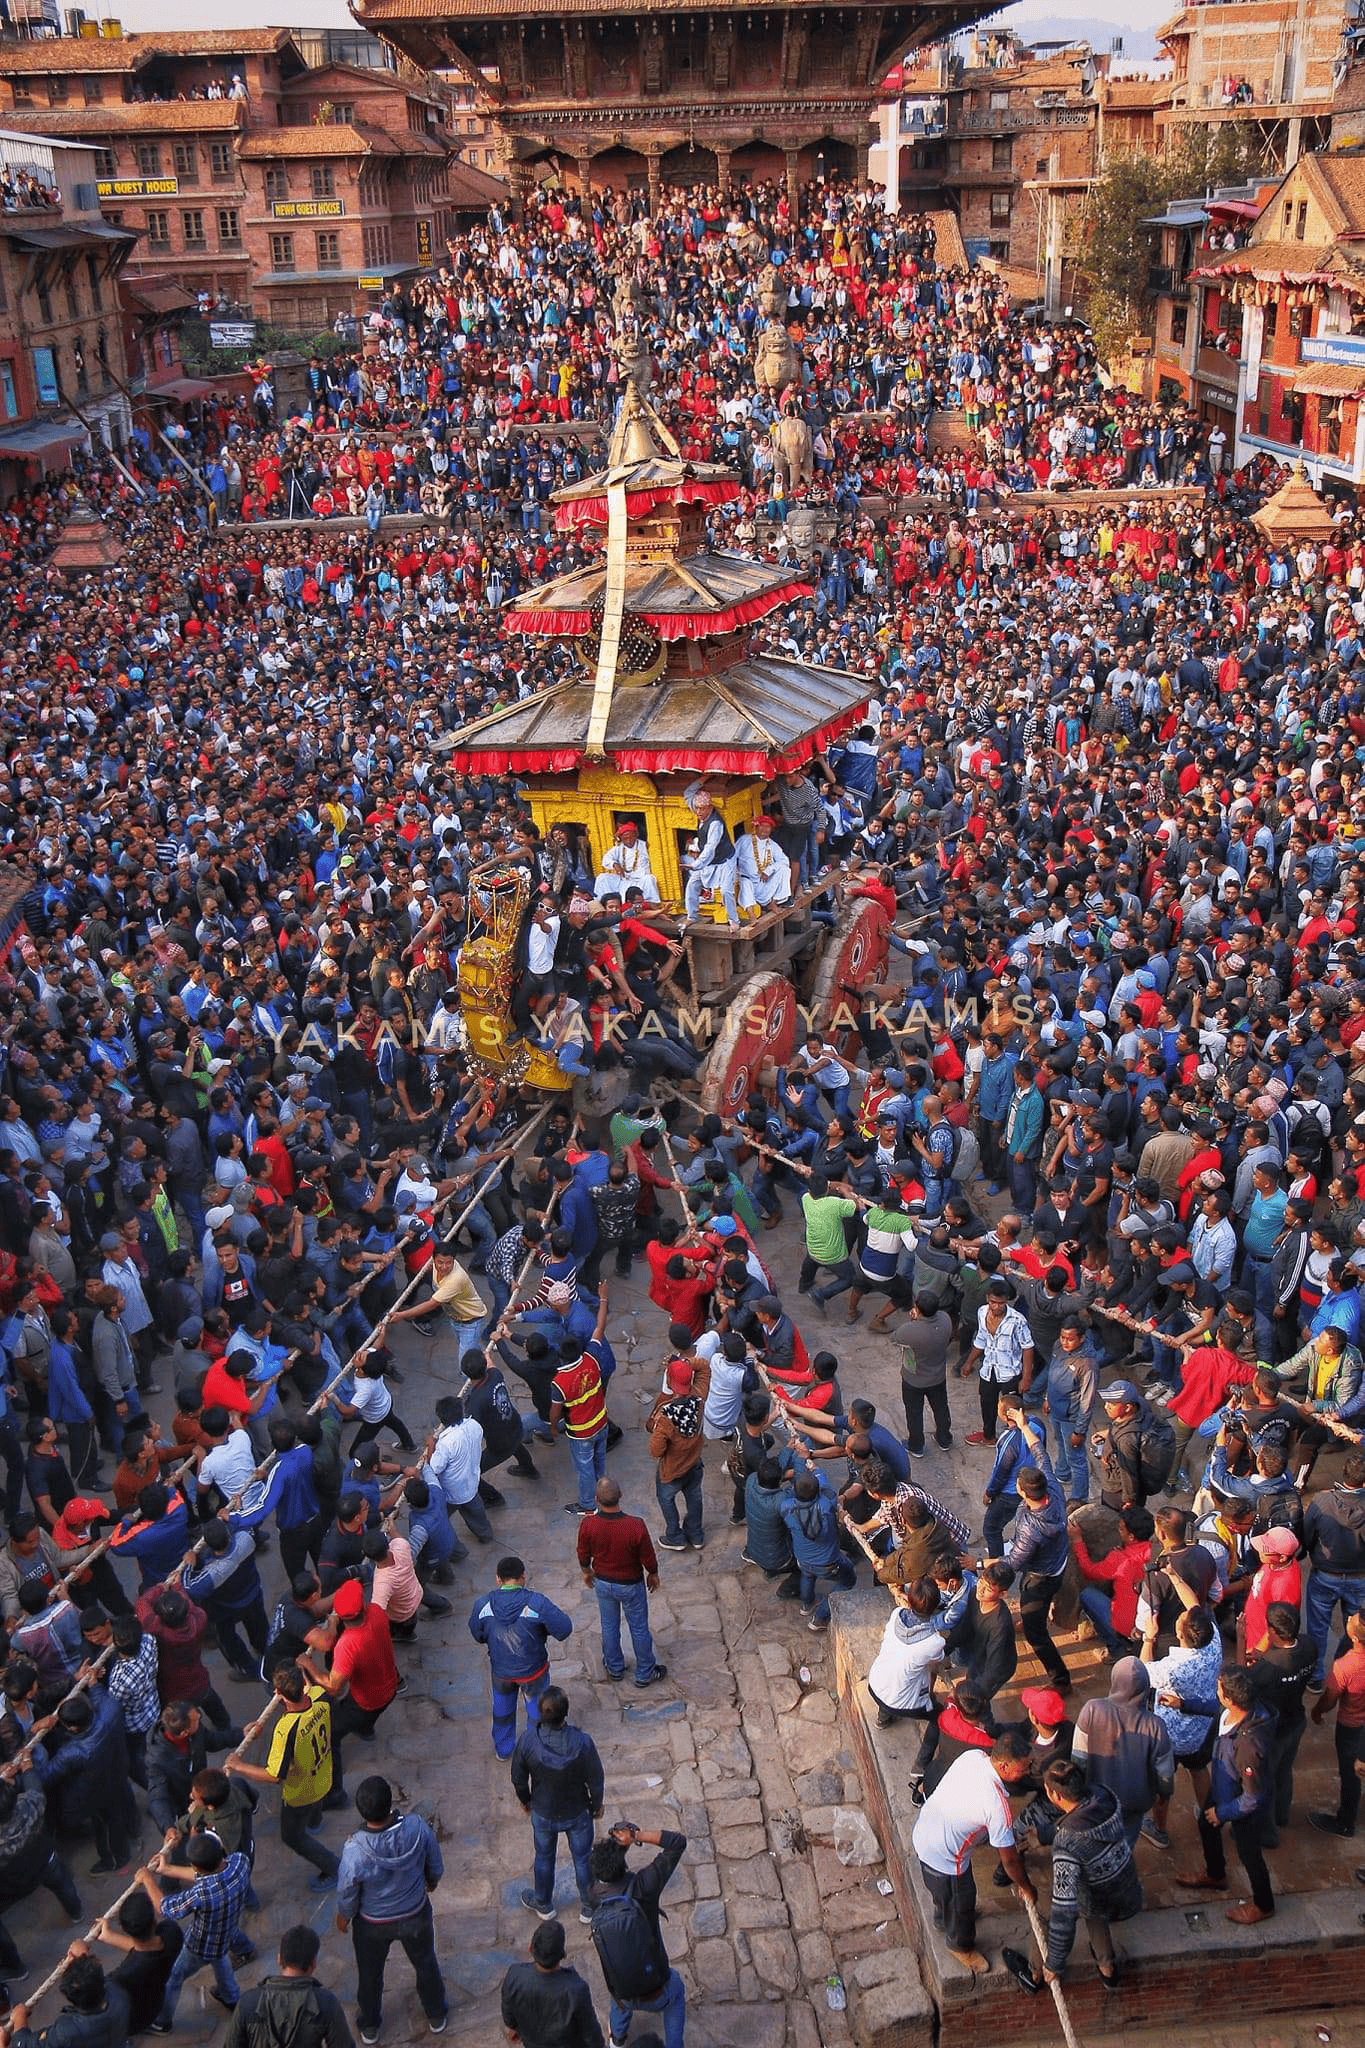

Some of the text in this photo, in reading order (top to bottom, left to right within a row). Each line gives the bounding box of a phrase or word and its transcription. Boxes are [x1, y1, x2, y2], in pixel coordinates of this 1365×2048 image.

[114, 182, 143, 194] GUEST
[146, 181, 176, 193] HOUSE
[318, 201, 340, 214] HOUSE
